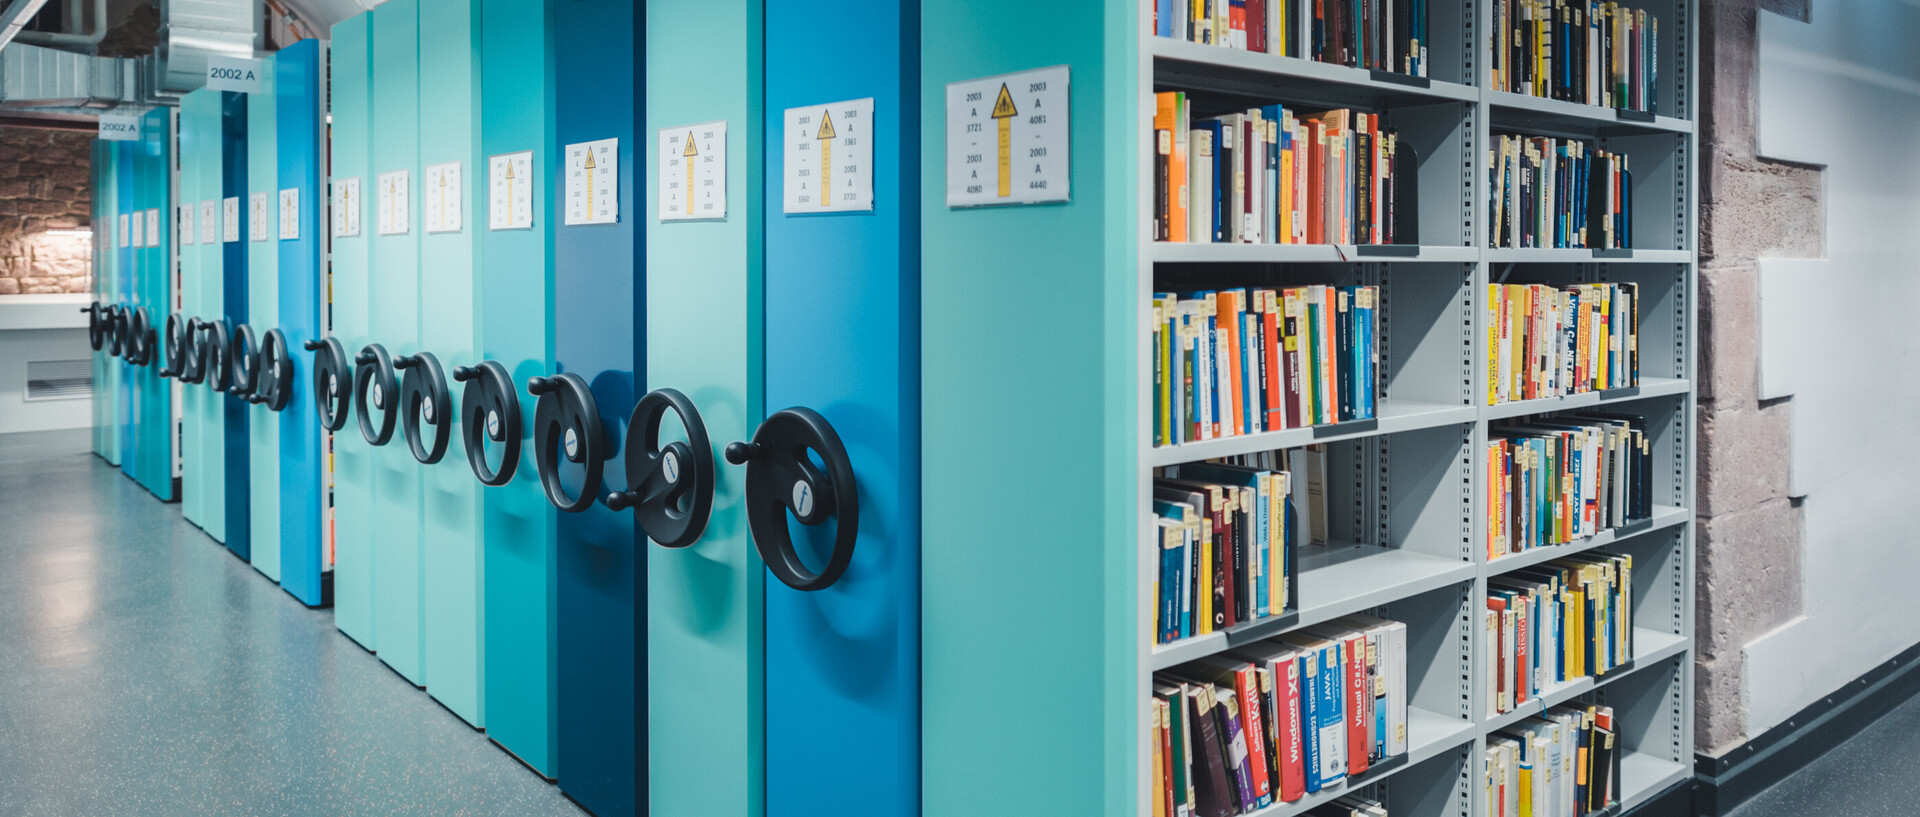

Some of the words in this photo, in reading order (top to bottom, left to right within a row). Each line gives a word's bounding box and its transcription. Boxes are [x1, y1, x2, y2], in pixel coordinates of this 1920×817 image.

[210, 68, 242, 80] 2002
[245, 70, 255, 80] A
[1029, 82, 1047, 92] 2003
[966, 92, 982, 102] 2003
[1035, 99, 1041, 109] A
[971, 108, 977, 117] A
[1029, 115, 1046, 125] 4081
[102, 122, 126, 132] 2002
[129, 123, 136, 132] A
[966, 124, 982, 133] 3721
[1030, 148, 1047, 158] 2003
[966, 154, 982, 164] 2003
[1035, 164, 1041, 174] A
[971, 170, 977, 179] A
[966, 185, 982, 194] 4080
[1030, 181, 1047, 190] 4440
[1288, 664, 1298, 696] XP
[1248, 687, 1259, 720] Kyli
[1289, 698, 1298, 763] Windows
